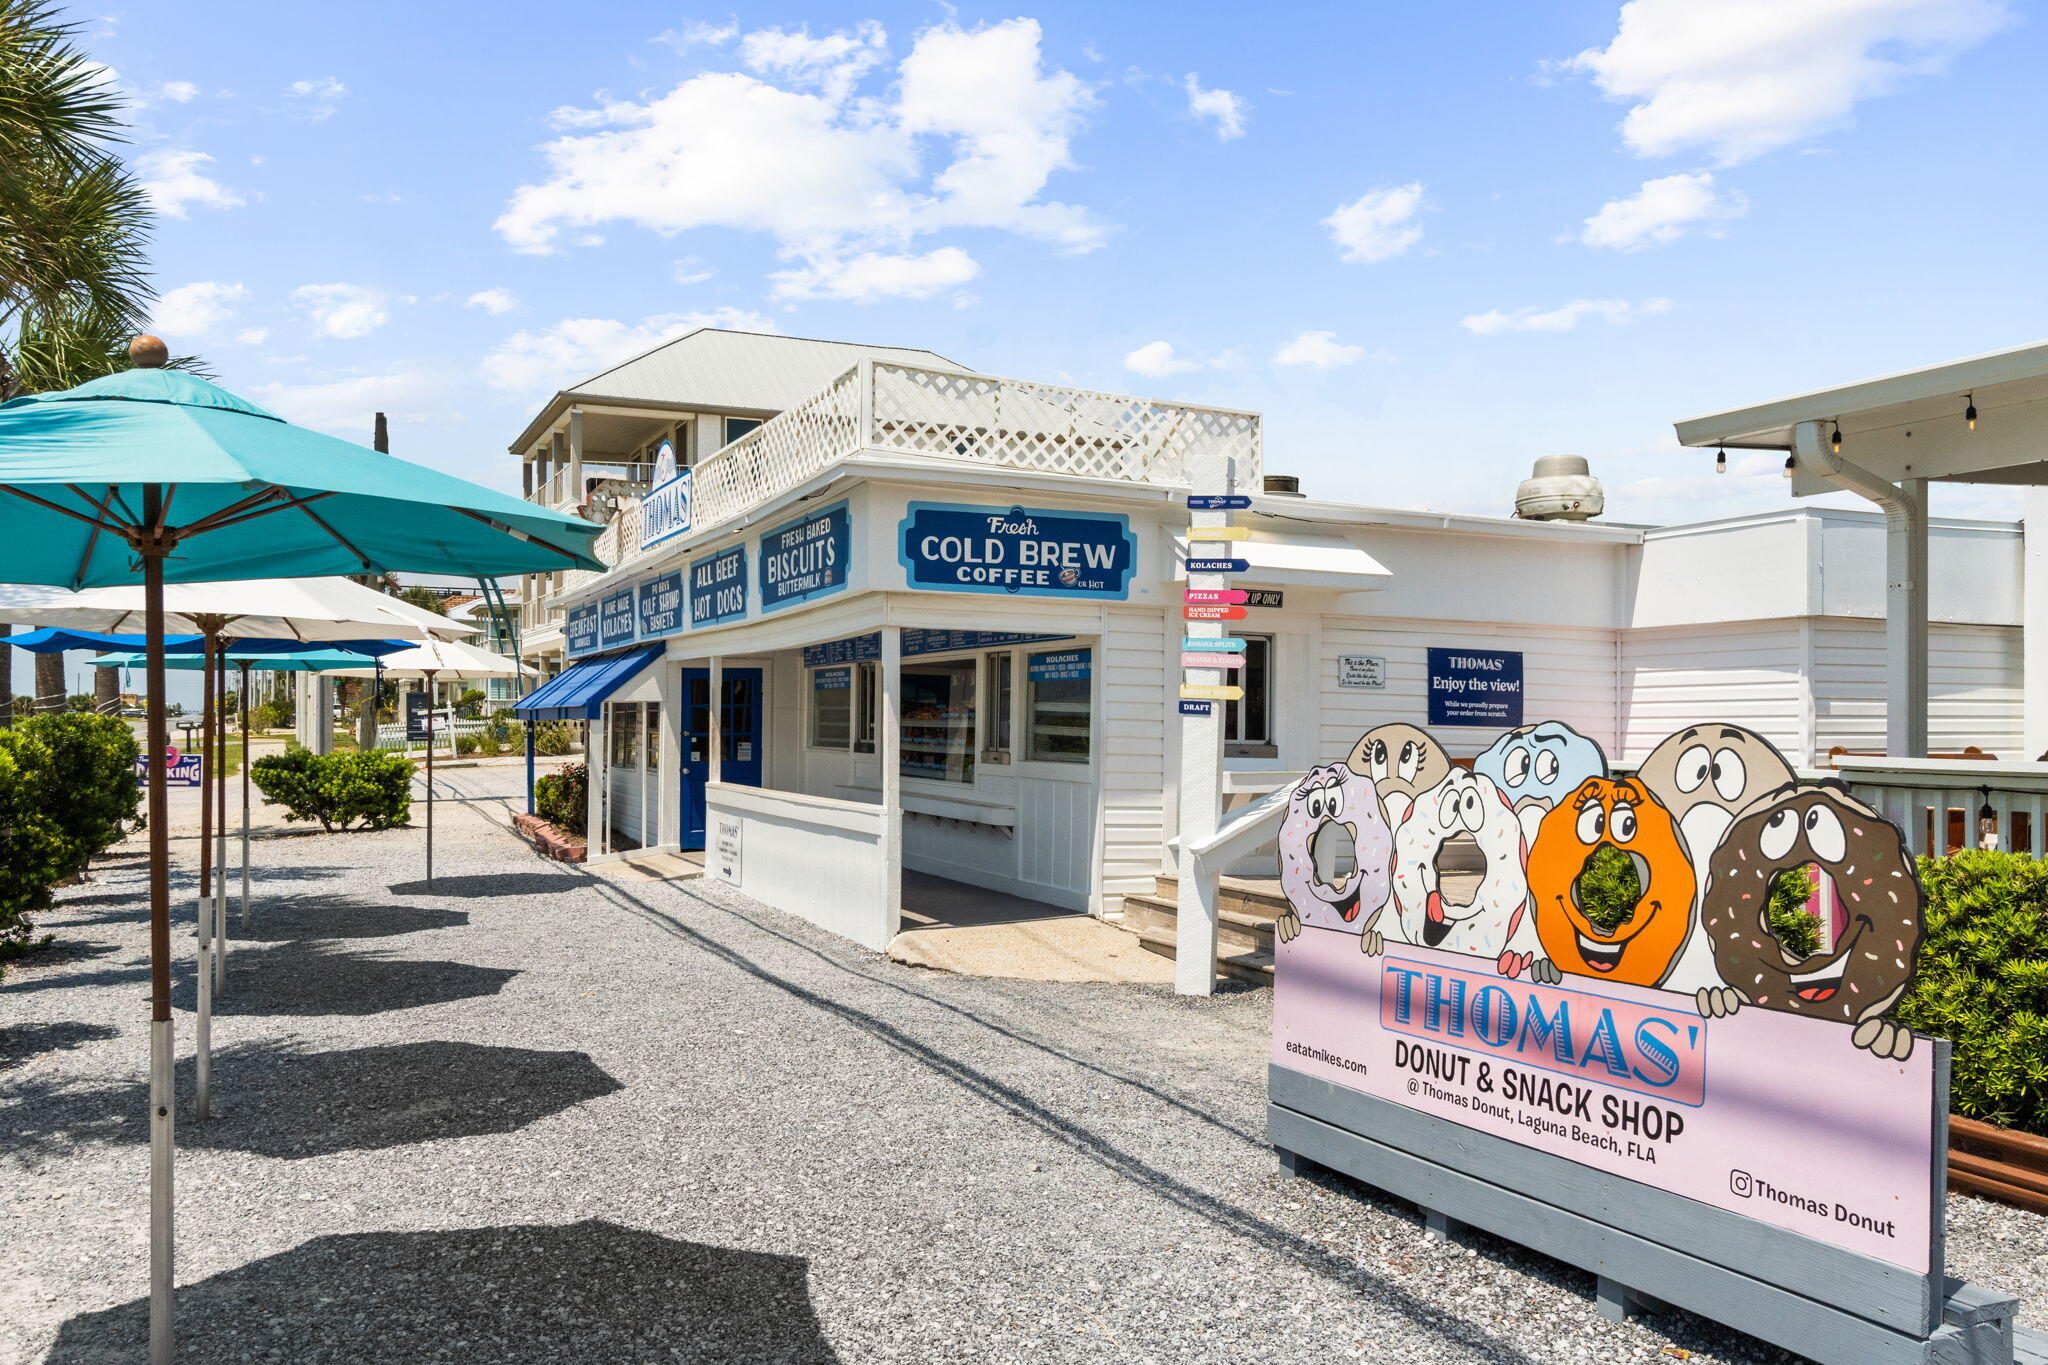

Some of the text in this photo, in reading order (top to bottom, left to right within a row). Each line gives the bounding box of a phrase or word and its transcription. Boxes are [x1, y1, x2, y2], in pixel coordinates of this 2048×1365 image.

[781, 517, 831, 550] FRESH BAKED
[987, 516, 1039, 536] Fresh
[768, 536, 835, 584] BISCUITS
[921, 536, 1116, 570] COLD BREW
[696, 554, 739, 589] ALL BEEF
[956, 566, 1050, 585] COFFEE
[777, 572, 821, 597] BUTTERMILK
[1089, 580, 1105, 589] HOT
[659, 589, 680, 612] SHRIMP
[694, 584, 743, 621] HOT DOGS
[1251, 592, 1262, 604] UP
[1262, 592, 1281, 604] ONLY
[569, 614, 597, 638] BREAKFAST
[603, 611, 632, 638] KOLACHES
[650, 610, 674, 631] BASKETS
[1046, 654, 1078, 664] KOLACHES
[1448, 656, 1505, 671] THOMAS'
[1432, 676, 1520, 693] Enjoy the view!
[135, 762, 200, 782] PKING
[1386, 966, 1699, 1087] THOMAS'
[1286, 1039, 1368, 1076] eatatmikes.com
[1395, 1039, 1684, 1144] DONUT & SNACK SHOP
[1407, 1077, 1657, 1164] @ Thomas Donut, Laguna Beach, FLA
[1755, 1179, 1896, 1239] Thomas Donut
